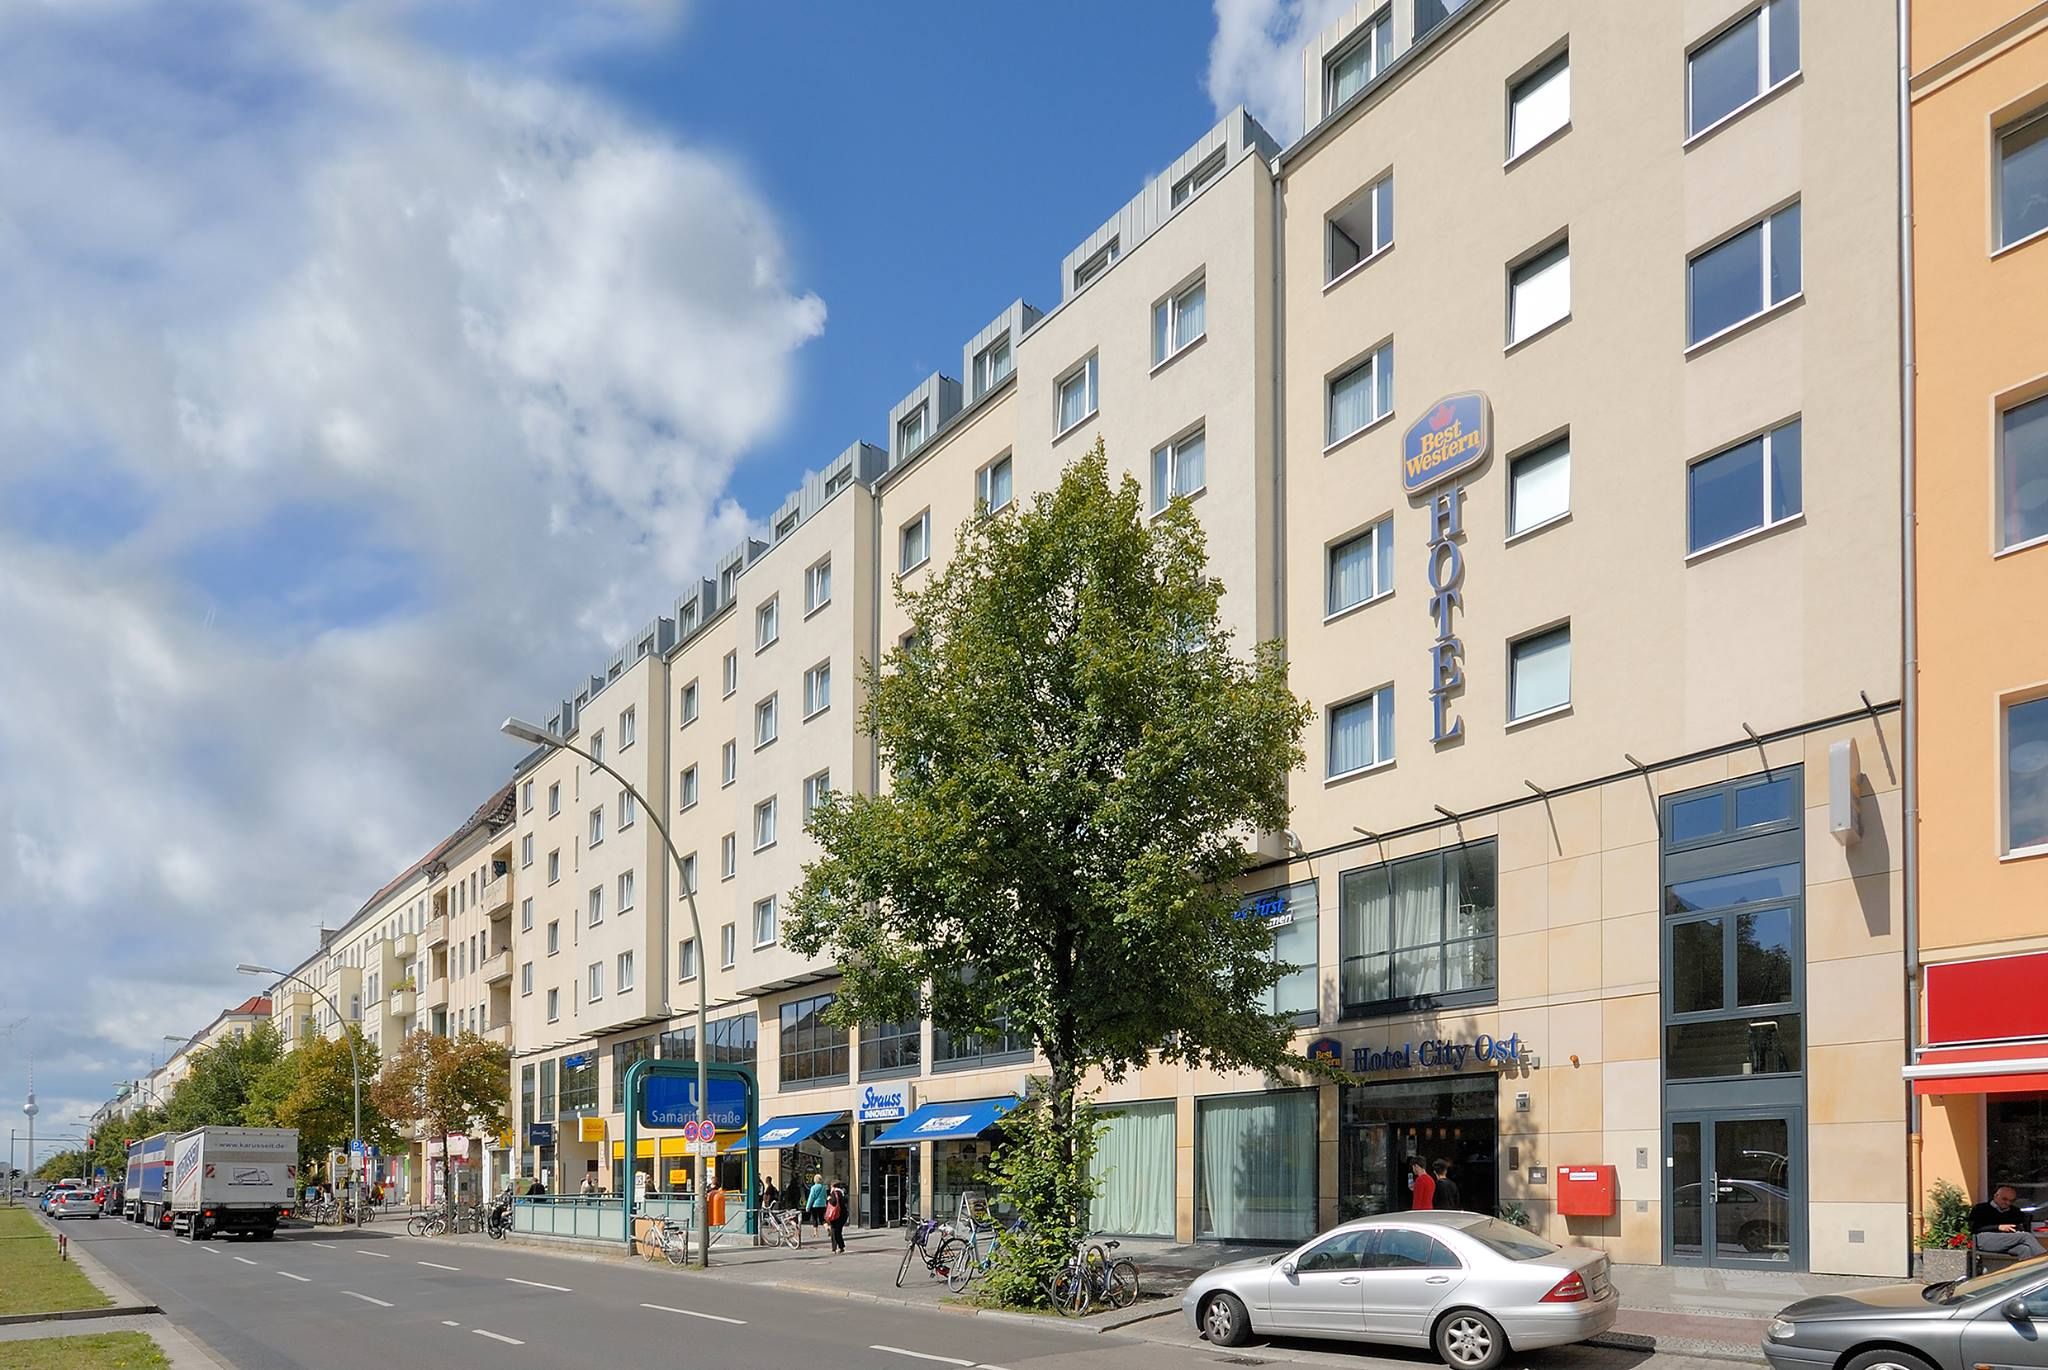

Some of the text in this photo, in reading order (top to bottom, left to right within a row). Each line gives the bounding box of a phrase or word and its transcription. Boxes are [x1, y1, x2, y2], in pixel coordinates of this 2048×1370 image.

[1420, 419, 1461, 456] Best
[1406, 429, 1480, 478] Western
[1427, 486, 1464, 744] HOTEL
[1316, 1050, 1333, 1061] Best
[1352, 1032, 1521, 1073] Hotel City Ost
[862, 1086, 902, 1109] Strauss
[652, 1110, 741, 1124] Samaritstraße
[864, 1108, 899, 1119] INNOVATION
